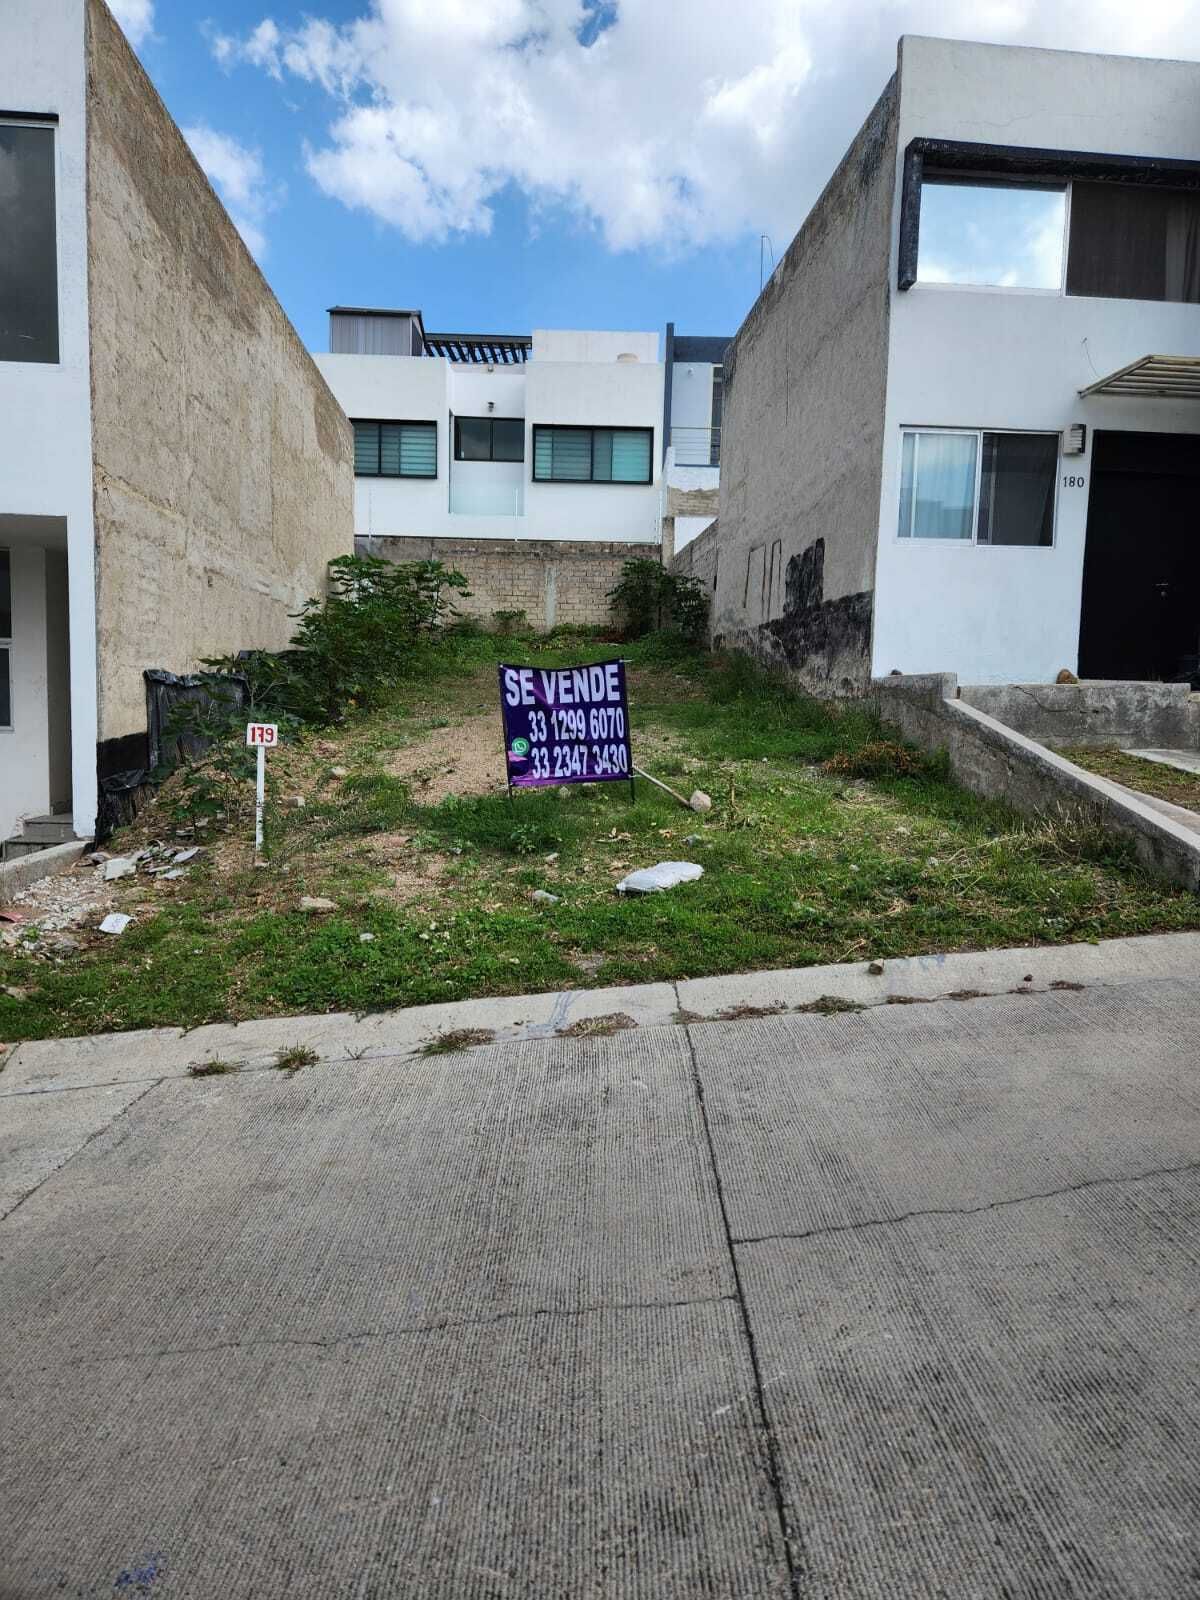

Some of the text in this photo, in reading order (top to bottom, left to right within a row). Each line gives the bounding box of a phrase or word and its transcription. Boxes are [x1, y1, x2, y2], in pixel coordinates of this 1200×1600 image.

[1063, 476, 1085, 488] 180
[504, 664, 621, 706] SE VENDE
[251, 726, 274, 743] 179
[528, 707, 624, 742] 33 1299 6070
[531, 743, 628, 779] 33 2347 3430
